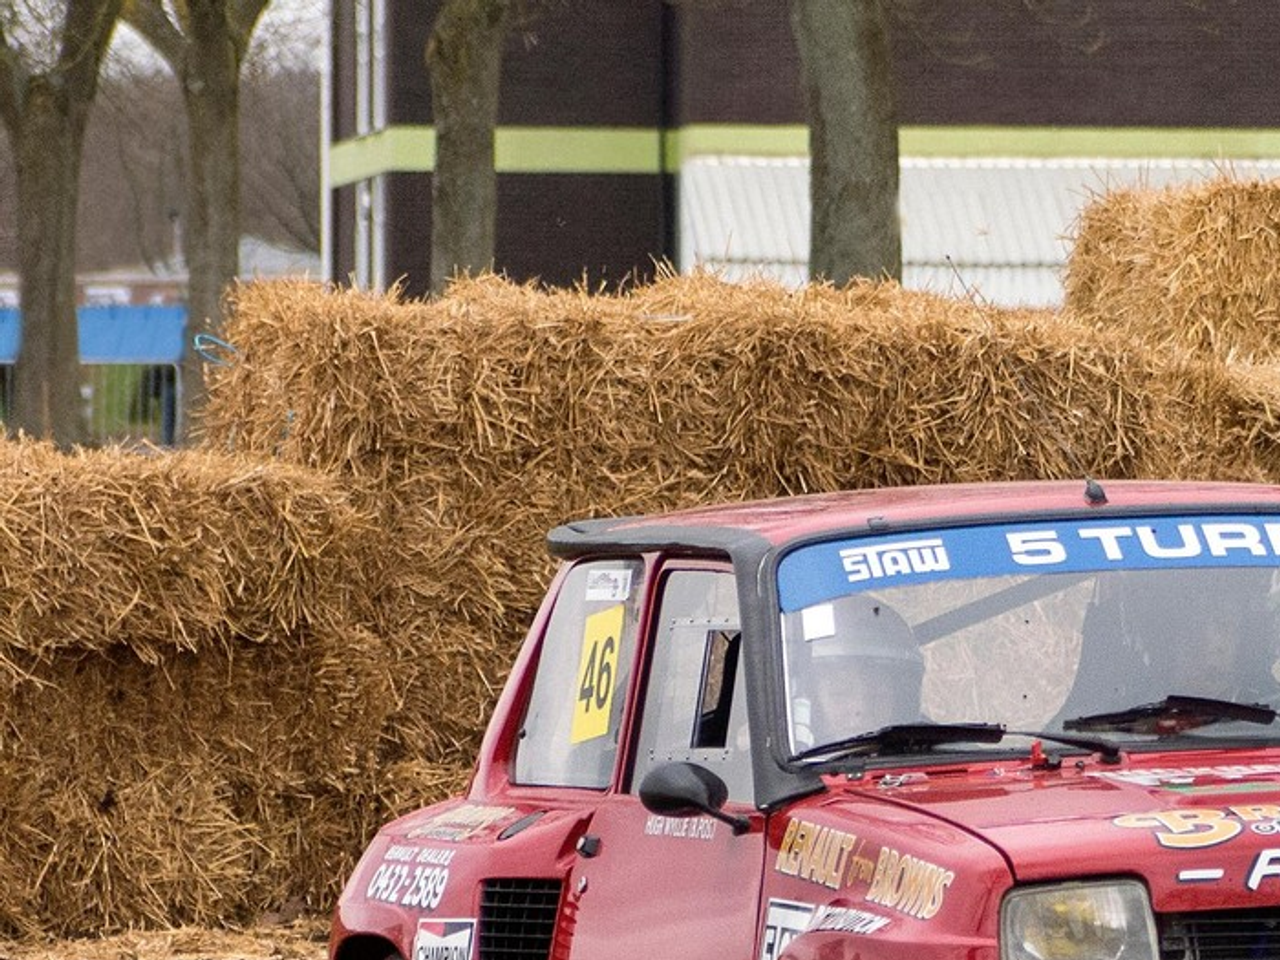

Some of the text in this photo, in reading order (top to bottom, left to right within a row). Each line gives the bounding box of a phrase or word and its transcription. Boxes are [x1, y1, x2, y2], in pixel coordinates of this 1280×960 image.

[839, 537, 949, 583] STAW
[1006, 529, 1067, 567] 5
[577, 636, 616, 714] 46
[774, 816, 857, 892] RENAULT
[865, 846, 956, 921] BROWNS
